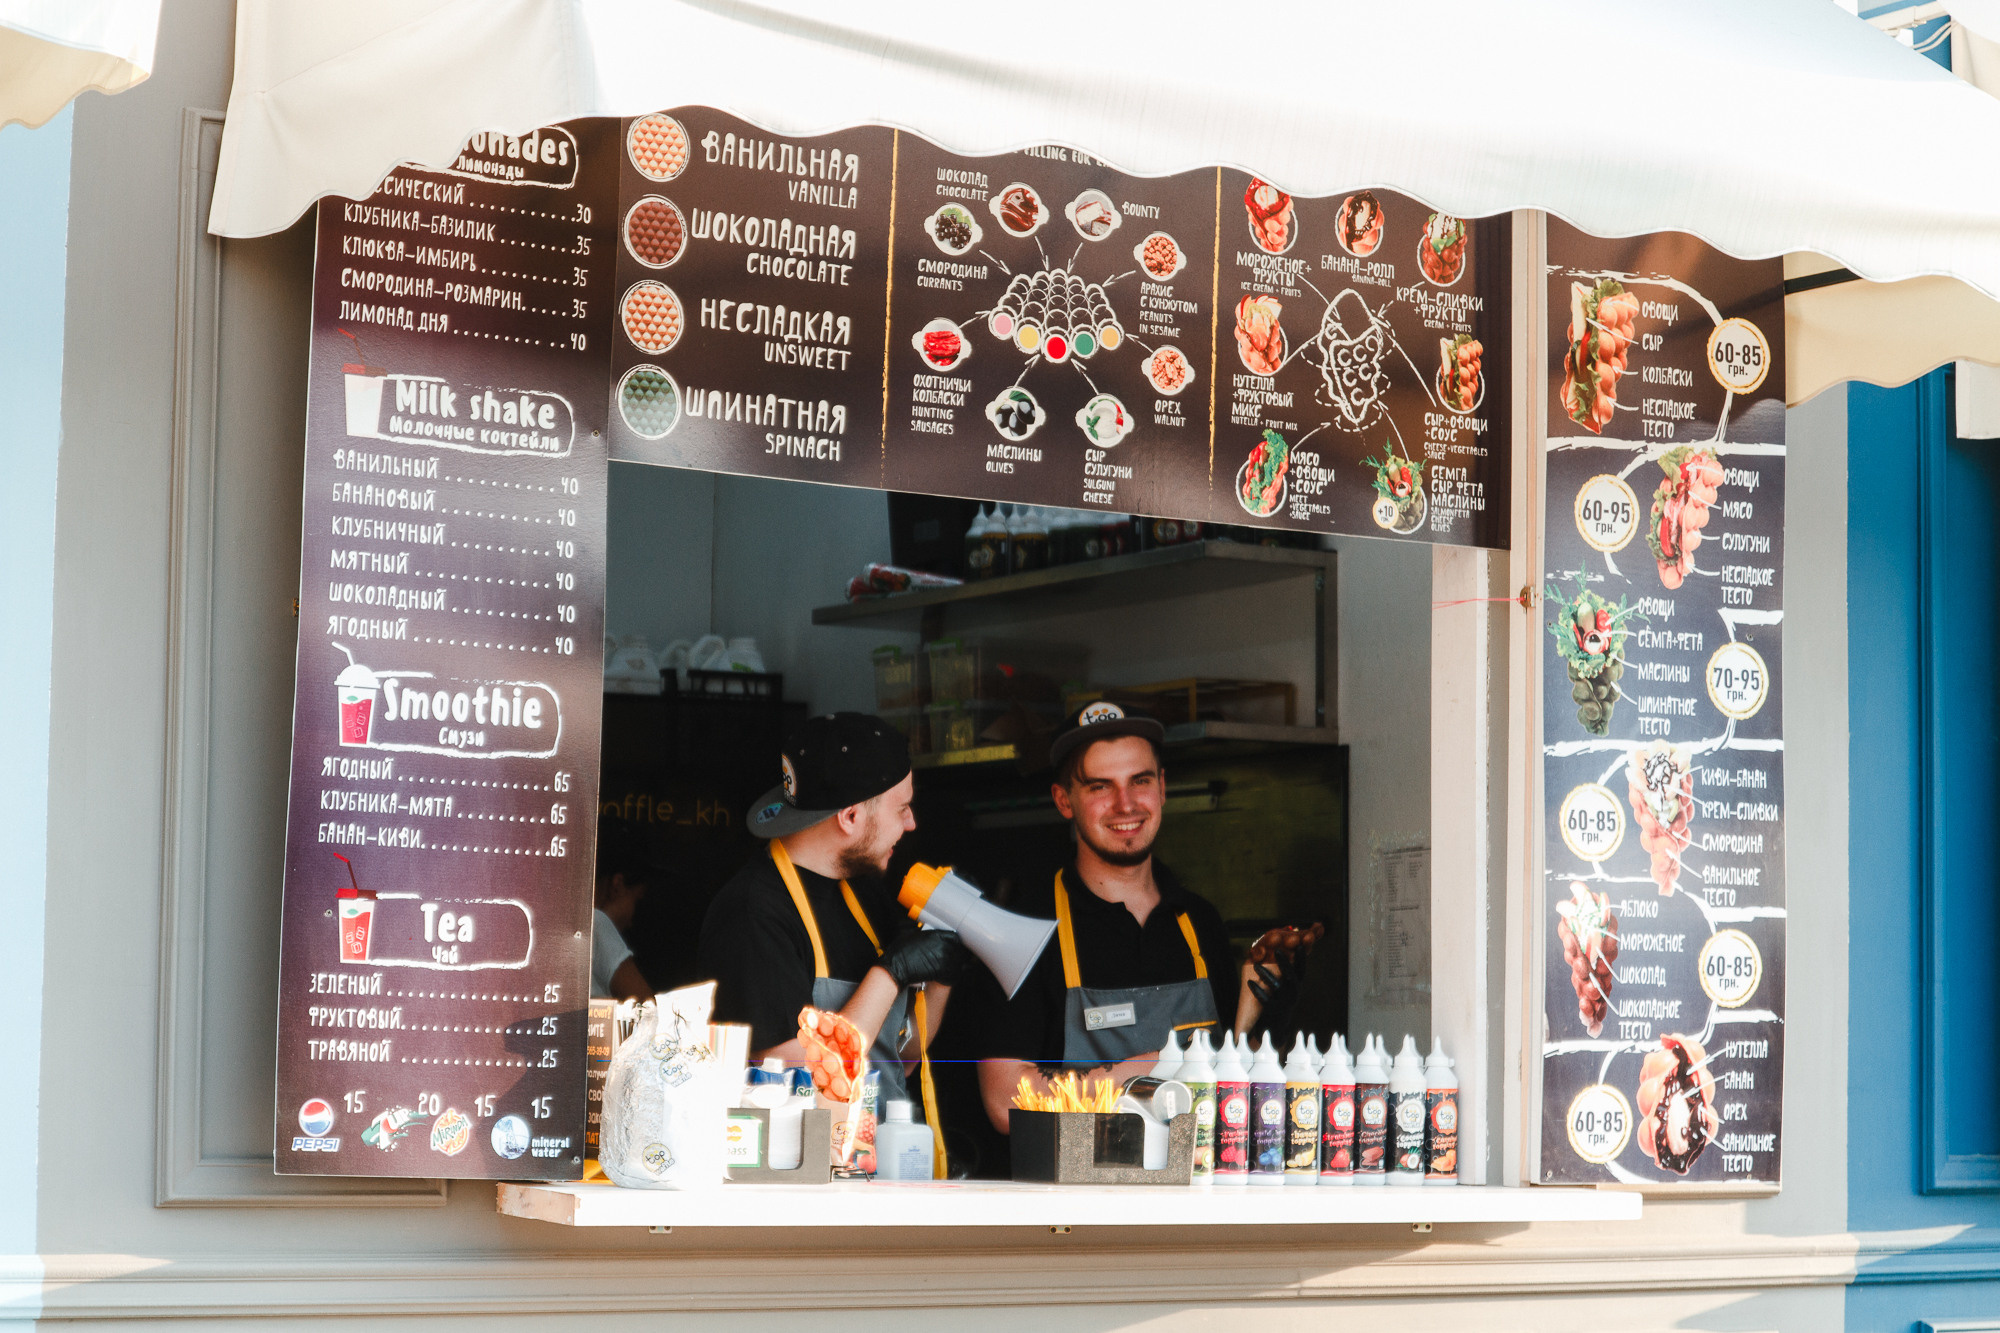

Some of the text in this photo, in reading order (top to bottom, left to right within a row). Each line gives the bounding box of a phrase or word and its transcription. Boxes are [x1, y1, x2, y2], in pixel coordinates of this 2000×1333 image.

[463, 130, 568, 165] onades
[701, 130, 860, 183] ВАНИЛЬНАЯ
[937, 167, 988, 188] ШОКОЛАД
[789, 180, 857, 209] VANILLA
[936, 184, 988, 201] CHOCOLATE
[576, 204, 591, 223] 30
[1122, 201, 1160, 219] BOUNTY
[345, 203, 591, 255] КЛУБНИКА-БАЗИЛИК 35
[691, 208, 856, 259] ШОКОЛАДНАЯ
[343, 236, 588, 287] КЛЮКВА-ИМБИРЬ 35
[747, 252, 853, 286] CHOCOLATE
[918, 258, 988, 280] СМОРОДИНА
[1321, 254, 1395, 279] БАНАНА-РОЛЛ
[917, 275, 963, 292] CURRANTS
[1253, 268, 1294, 287] ФРУКТЫ
[1352, 275, 1391, 287] BANANA-ROLL
[341, 268, 587, 318] СМОРОДИНА-РОЗМАРИН 35
[1141, 282, 1174, 298] АРАХИС
[1241, 282, 1301, 297] ICE CREAM FRUITS
[1396, 286, 1483, 311] КРЕМ-СЛИВКИ
[1140, 296, 1198, 314] С КУНЖУТОМ
[1642, 301, 1679, 326] ОВОЩИ
[339, 301, 586, 350] ЛИМОНАД ДНЯ 40
[701, 298, 851, 345] НЕСЛАДКАЯ
[1140, 310, 1174, 324] PEANUTS
[1424, 319, 1472, 332] CREAM FRUITS
[1139, 324, 1181, 337] IN SESAME
[1642, 334, 1663, 351] СЫР
[764, 341, 851, 370] UNSWEET
[1715, 342, 1761, 366] 60-85
[913, 374, 971, 392] ОХОТНИЧЬИ
[1233, 374, 1274, 391] НУТЕЛЛА
[1643, 366, 1693, 387] КОЛБАСКИ
[396, 379, 555, 429] Milk shake
[913, 389, 965, 406] КОЛБАСКИ
[1155, 400, 1181, 414] ОРЕХ
[686, 386, 846, 434] ШПИНАТНАЯ
[912, 405, 953, 420] HUNTING
[1232, 403, 1262, 418] МИКС
[1642, 399, 1697, 420] НЕСЛАДКОЕ
[911, 420, 954, 435] SAUSAGES
[1154, 414, 1186, 427] WALNUT
[1231, 416, 1298, 431] NUTELLA FRUIT MIX
[1642, 419, 1674, 438] ТЕСТО
[390, 416, 559, 451] Молочные коктейли
[765, 433, 840, 461] SPINACH
[987, 444, 1042, 462] МАСЛИНЫ
[1085, 449, 1106, 462] СЫР
[986, 461, 1014, 474] OLIVES
[1290, 451, 1320, 466] МЯСО
[333, 449, 578, 495] ВАНИЛЬНЫЙ 40
[1085, 463, 1133, 479] СУЛУГУНИ
[1431, 465, 1467, 481] СЕМГА
[1724, 468, 1759, 492] ОВОЩИ
[1084, 478, 1115, 490] SULGUNI
[1431, 479, 1483, 496] СЫР ФЕТА
[333, 482, 576, 526] БАНАНОВЫЙ 40
[1083, 492, 1112, 504] CHEESE
[1432, 493, 1485, 511] МАСЛИНЫ
[1583, 500, 1630, 523] 60-95
[1723, 501, 1753, 520] МЯСО
[332, 516, 574, 559] КЛУБНИЧНЫЙ 40
[1722, 533, 1770, 553] СУЛУГУНИ
[331, 550, 574, 590] МЯТНЫЙ 40
[1722, 565, 1775, 586] НЕСЛАДКОЕ
[329, 582, 575, 623] ШОКОЛАДНЫЙ 40
[1721, 586, 1753, 605] ТЕСТО
[1638, 598, 1675, 622] ОВОЩИ
[327, 616, 573, 655] ЯГОДНЫЙ 40
[1638, 663, 1690, 682] МАСЛИНЫ
[1714, 668, 1760, 690] 70-95
[383, 678, 541, 728] Smoothie
[1638, 695, 1697, 716] ШПИНАТНОЕ
[1638, 717, 1670, 736] ТЕСТО
[439, 727, 484, 748] Смузи
[321, 757, 570, 792] ЯГОДНЫЙ 65
[1701, 767, 1766, 789] КИВИ-БАНАН
[320, 790, 567, 825] КЛУБНИКА-МЯТА 65
[1702, 801, 1778, 822] КРЕМ-СЛИВКИ
[1568, 809, 1616, 831] 60-85
[318, 822, 567, 857] БАНАН-КИВИ 65
[1703, 833, 1763, 855] СМОРОДИНА
[1702, 865, 1761, 887] ВАНИЛЬНОЕ
[1703, 887, 1736, 907] ТЕСТО
[1620, 900, 1658, 919] ЯБЛОКО
[420, 903, 473, 943] Tea
[1620, 933, 1685, 953] МОРОЖЕНОЕ
[432, 946, 458, 964] Чай
[1620, 966, 1666, 987] ШОКОЛАД
[1707, 956, 1752, 977] 60-85
[309, 973, 560, 1003] ЗЕЛЕНЫЙ 25
[1620, 999, 1682, 1021] ШОКОЛАДНОЕ
[308, 1007, 558, 1035] ФРУКТОВЫЙ 25
[1619, 1022, 1651, 1040] ТЕСТО
[308, 1039, 558, 1068] ТРАВЯНОЙ 25
[1724, 1072, 1754, 1090] БАНАН
[344, 1091, 552, 1118] 15 20 15 15
[1724, 1104, 1747, 1121] ОРЕХ
[1575, 1111, 1623, 1132] 60-85
[292, 1138, 339, 1151] PEPSI
[532, 1137, 569, 1148] mineral
[532, 1147, 561, 1158] water
[1723, 1155, 1753, 1172] ТЕСТО
